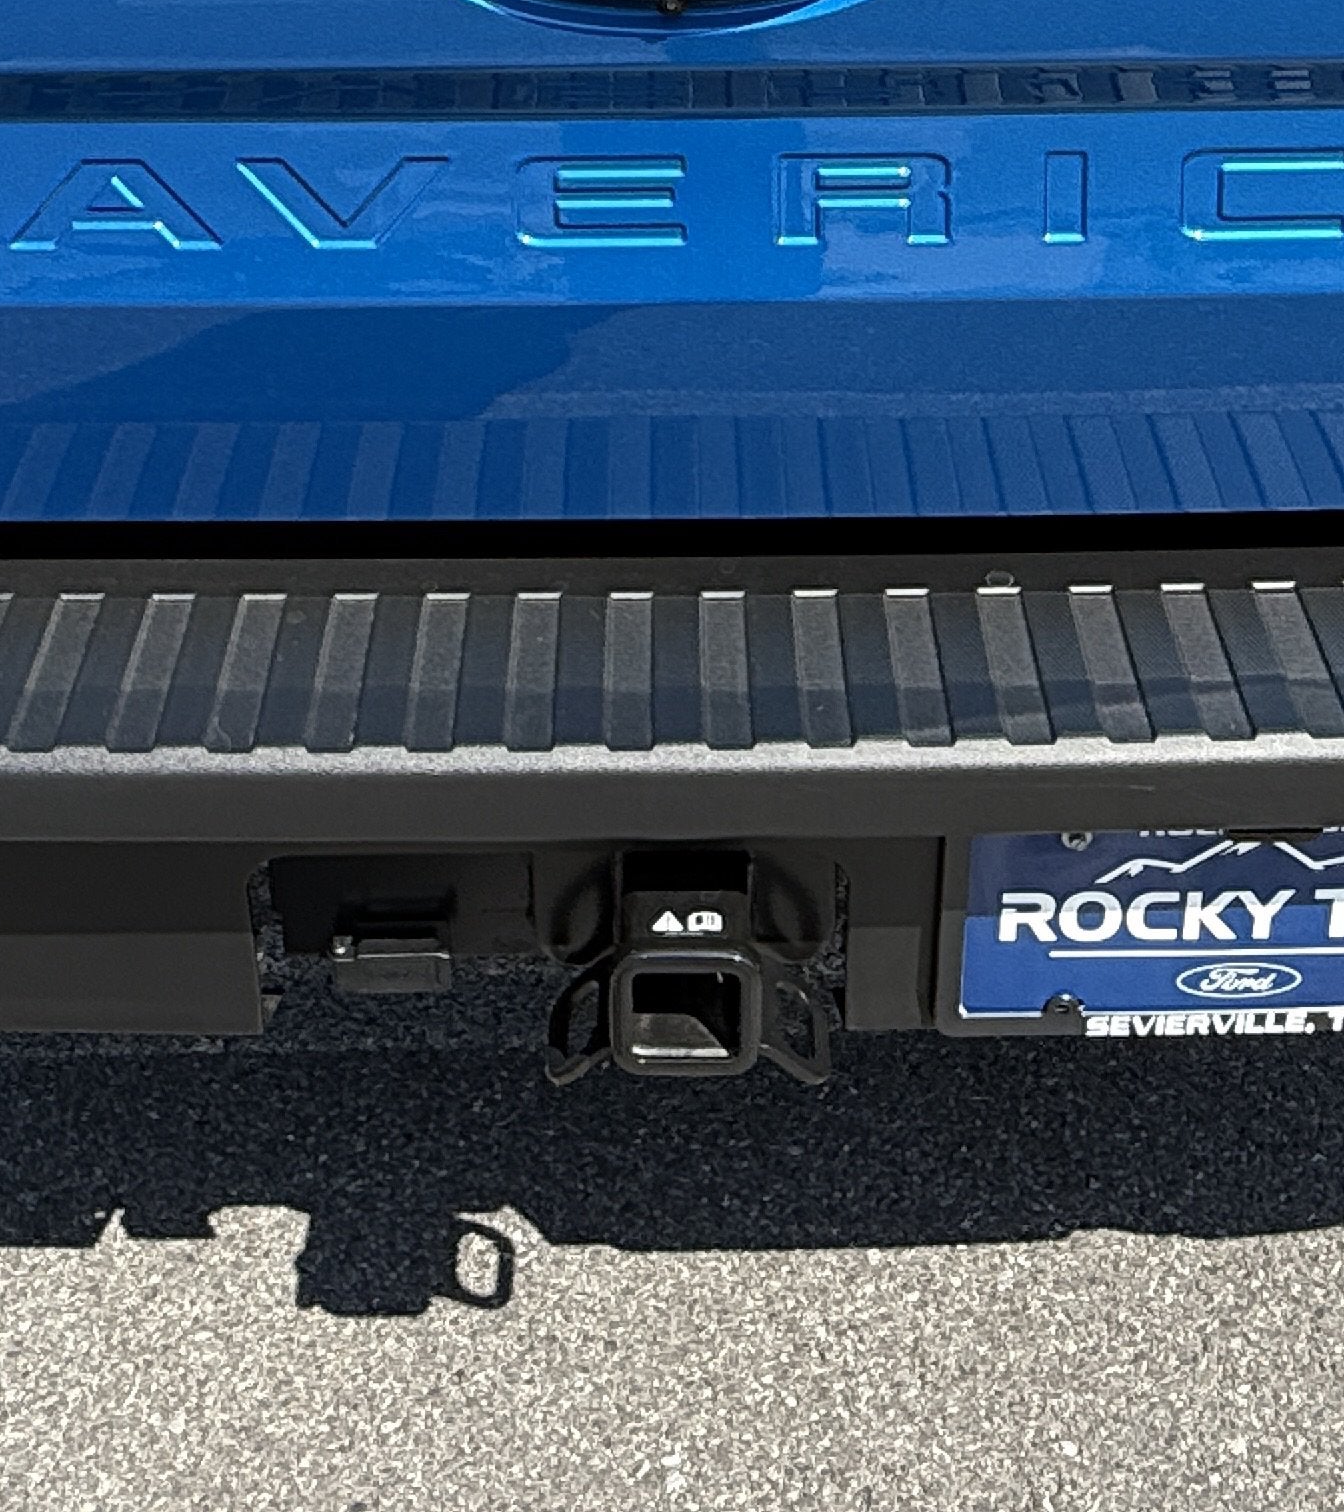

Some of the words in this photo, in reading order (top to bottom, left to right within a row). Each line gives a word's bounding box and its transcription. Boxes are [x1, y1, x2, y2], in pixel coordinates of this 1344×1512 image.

[997, 889, 1297, 943] ROCKY
[1199, 967, 1278, 992] Ford
[1086, 1011, 1316, 1038] SEVIERVILLE,
